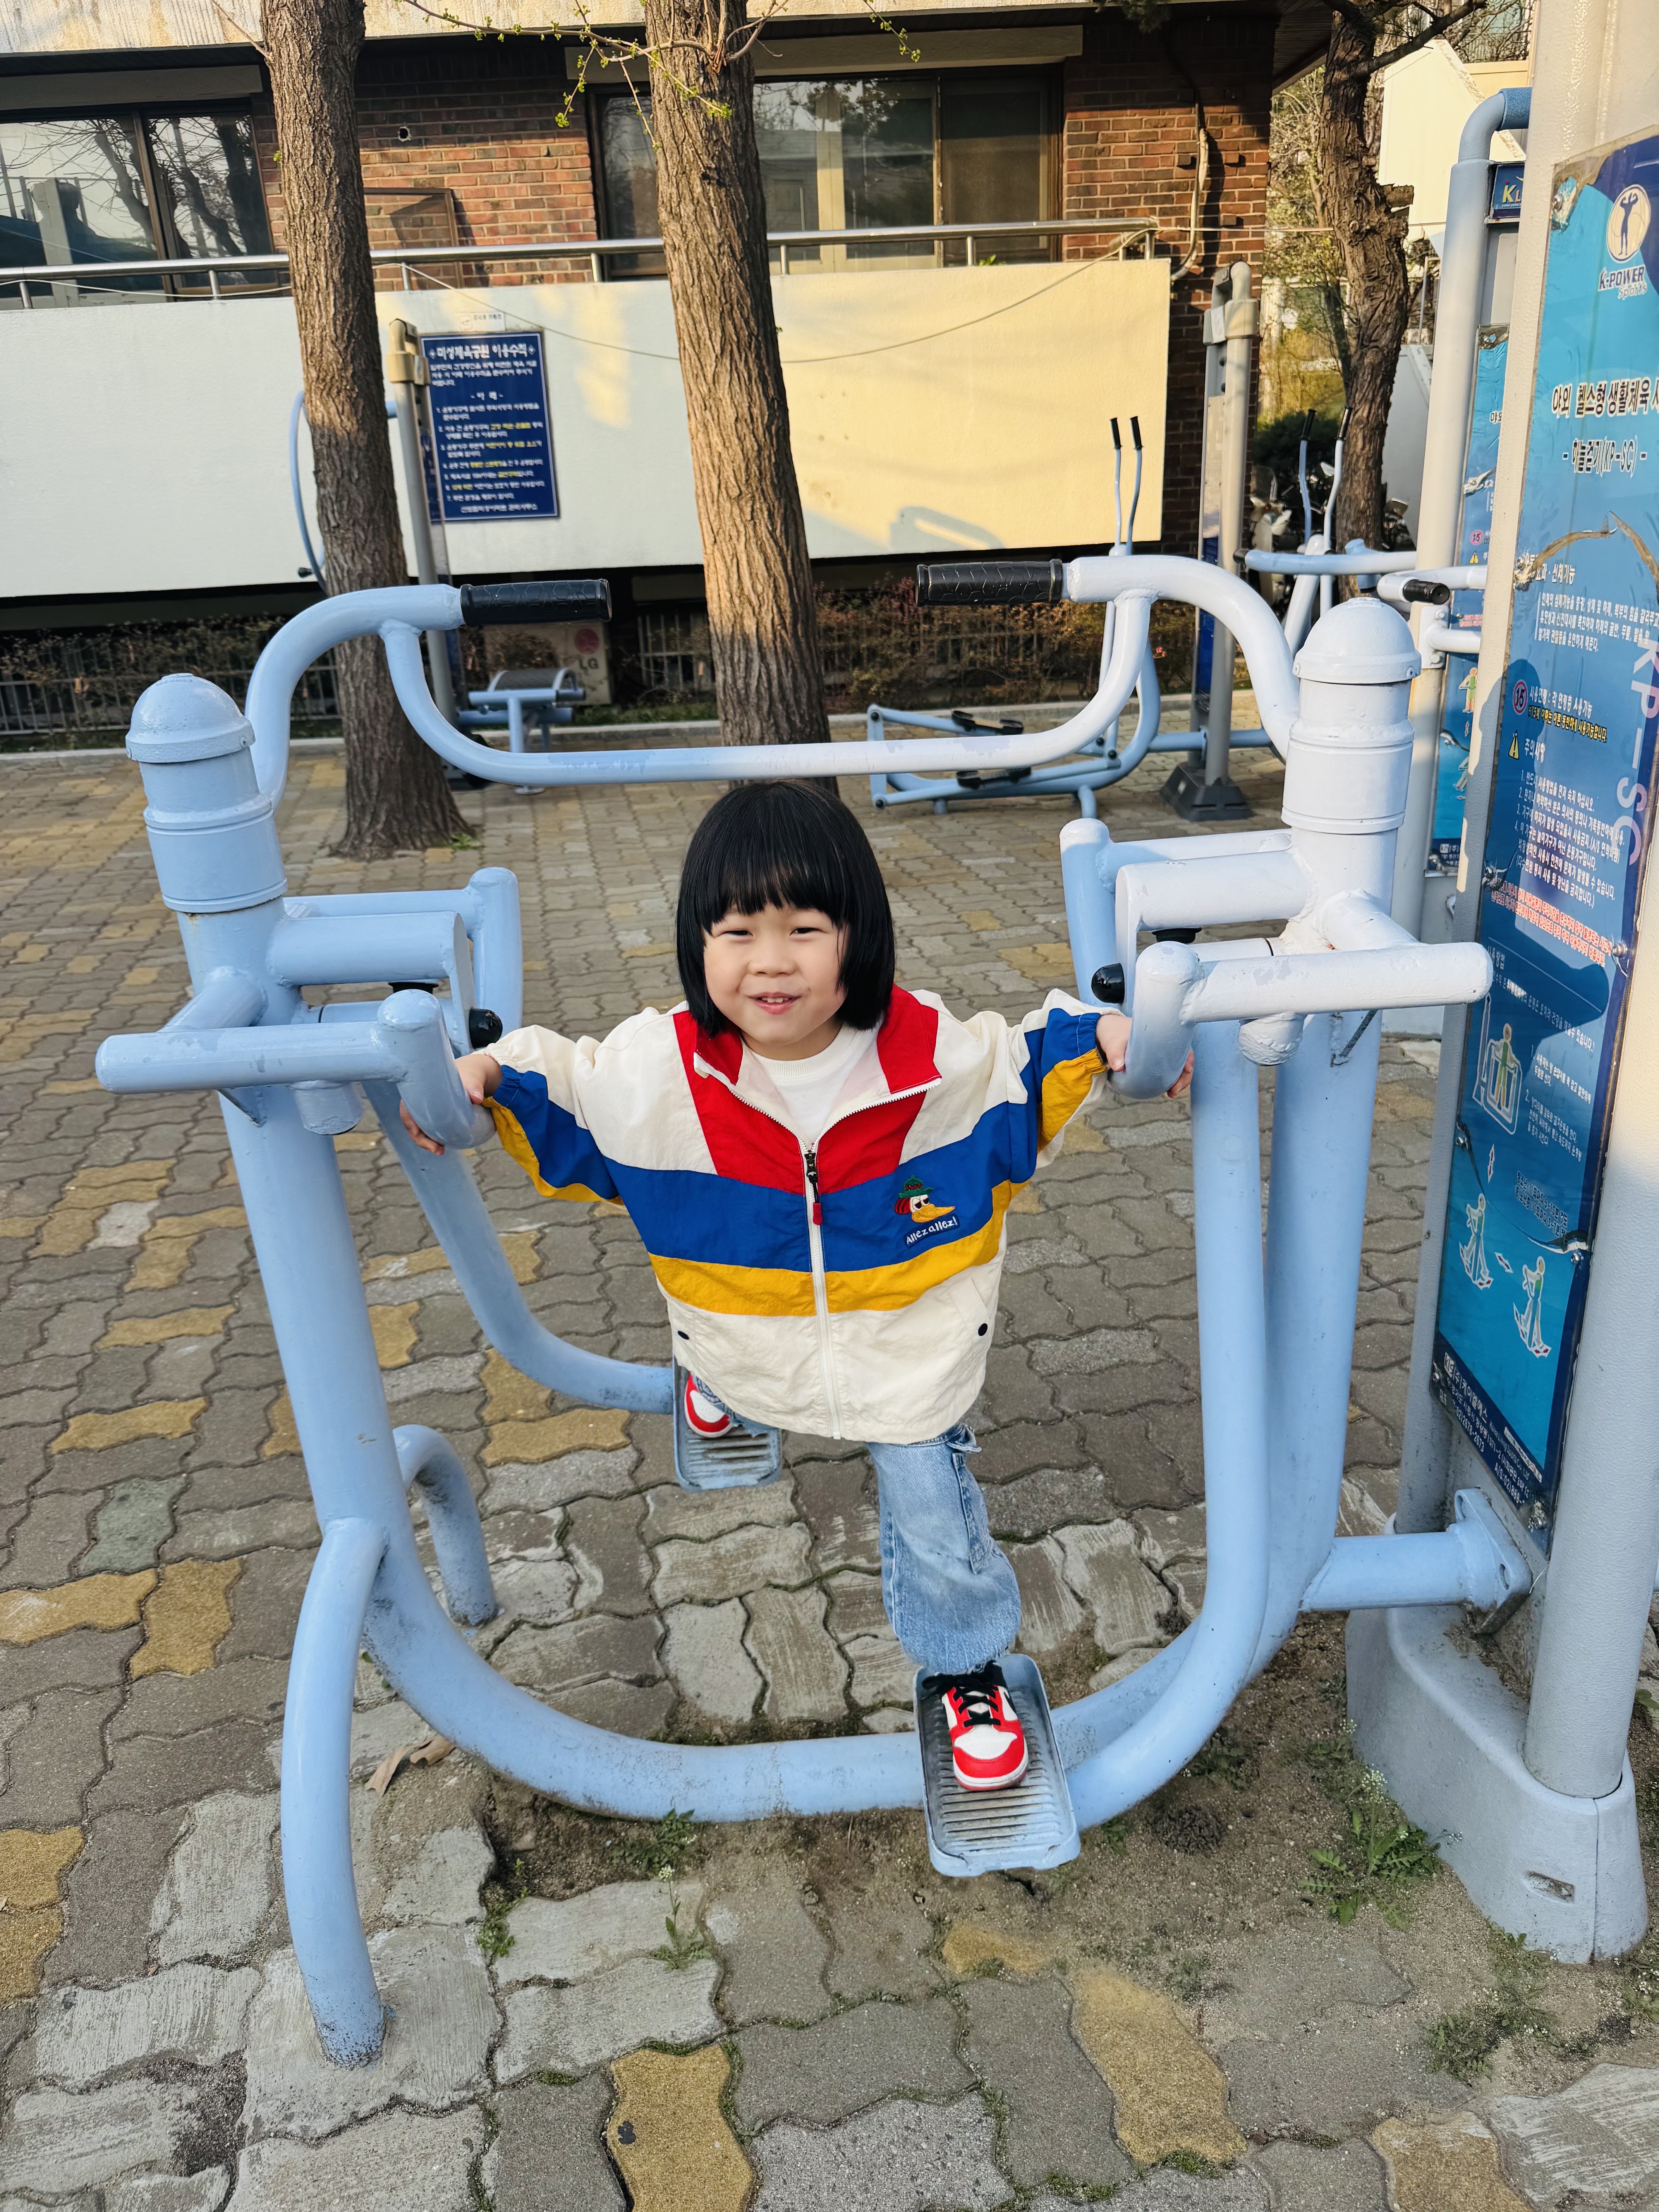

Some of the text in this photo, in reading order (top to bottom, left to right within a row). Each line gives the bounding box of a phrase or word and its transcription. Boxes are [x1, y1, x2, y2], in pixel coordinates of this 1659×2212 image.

[1599, 266, 1645, 290] K-POWER
[1552, 384, 1572, 418] 야외
[579, 658, 598, 669] LG
[1516, 688, 1525, 708] 15
[1525, 738, 1545, 763] 주의사항
[907, 1216, 957, 1244] Allez allez!
